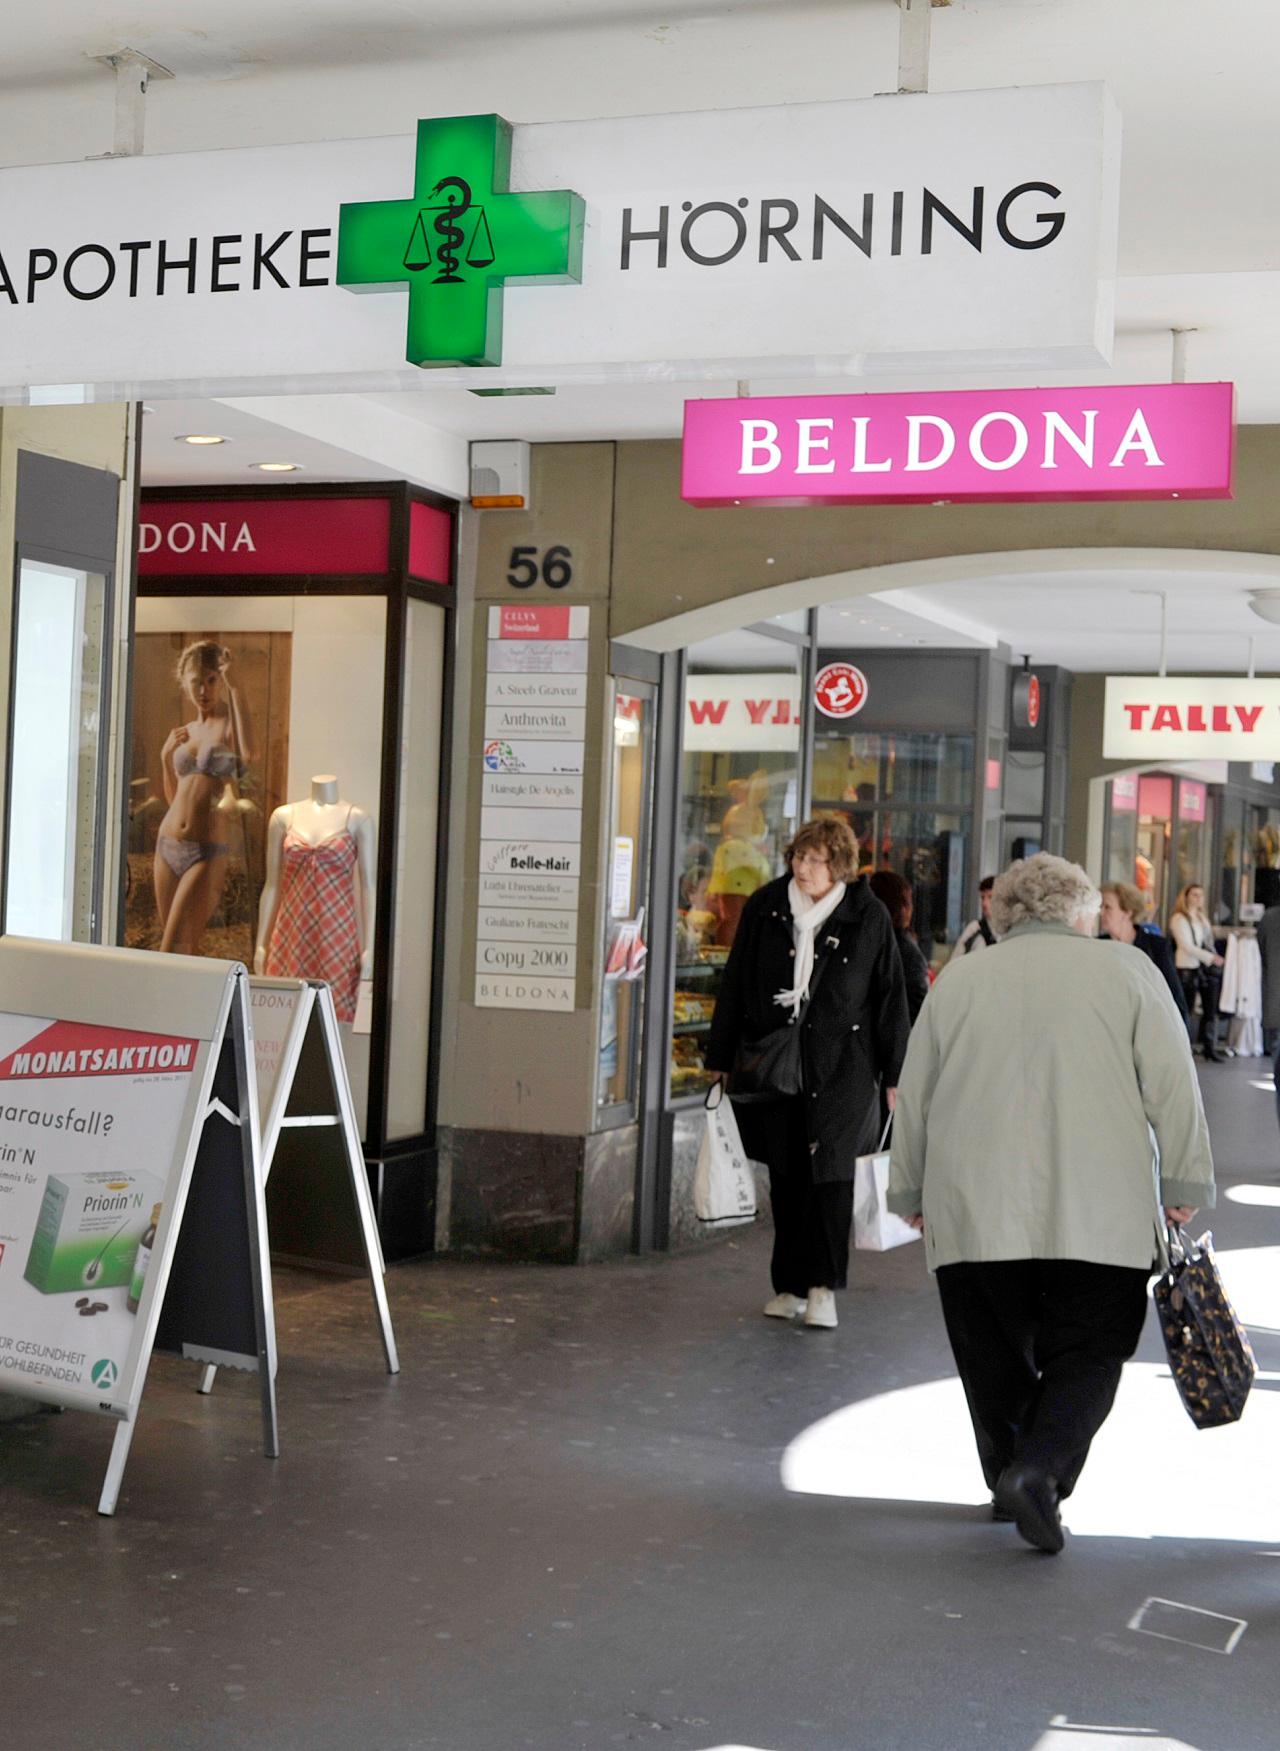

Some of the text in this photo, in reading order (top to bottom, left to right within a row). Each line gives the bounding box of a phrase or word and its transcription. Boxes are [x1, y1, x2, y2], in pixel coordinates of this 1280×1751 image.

[620, 181, 1066, 269] HÖRNING
[738, 407, 1165, 475] BELDONA
[138, 521, 257, 553] DONA
[507, 546, 572, 589] 56
[539, 685, 578, 696] Graveur
[501, 712, 567, 727] Anthrovita
[1123, 704, 1264, 732] TALLY
[510, 856, 571, 871] Belle-Hair
[484, 946, 568, 968] Copy 2000
[251, 993, 293, 1009] LDONA
[480, 985, 570, 1000] BELDONA
[10, 1044, 192, 1076] MONATSAKTION
[22, 1149, 36, 1165] N
[24, 1173, 37, 1185] für
[83, 1192, 144, 1212] Priorin N
[15, 1340, 87, 1366] GESUNDHEIT
